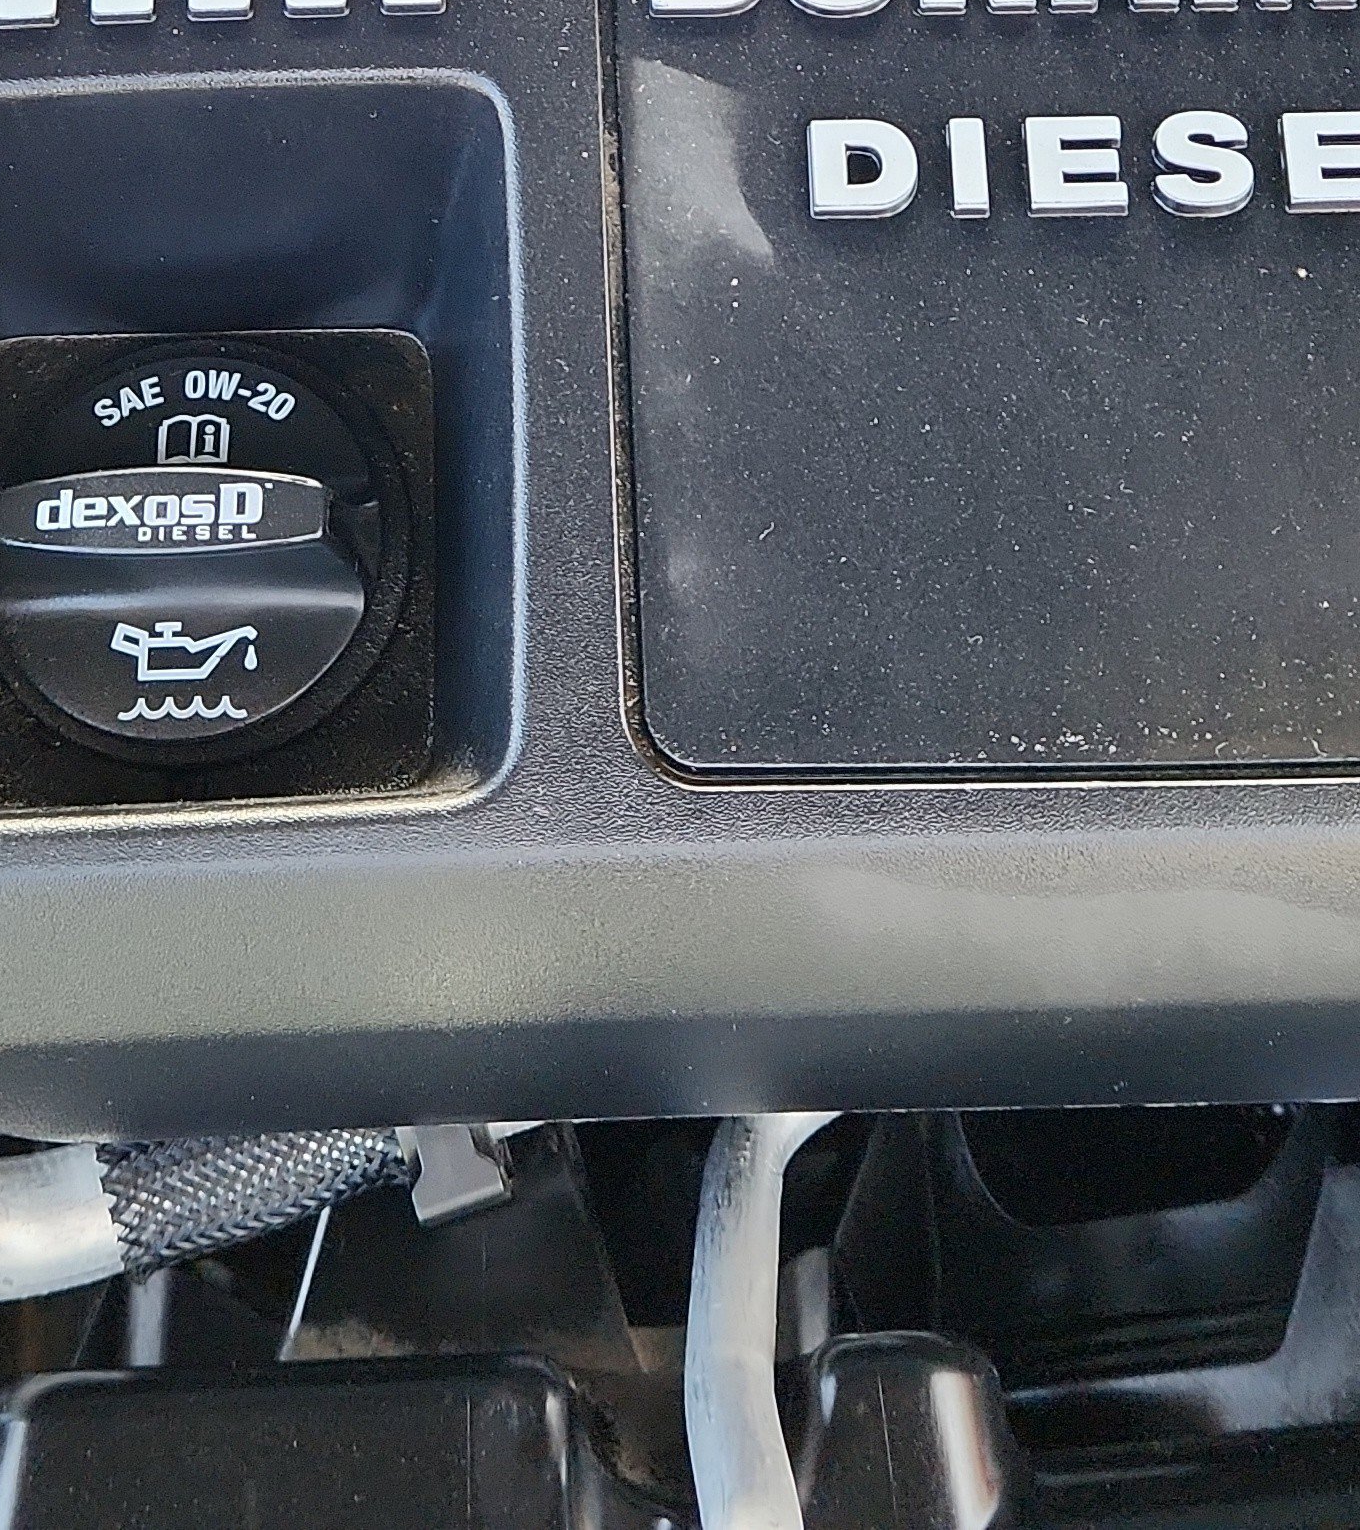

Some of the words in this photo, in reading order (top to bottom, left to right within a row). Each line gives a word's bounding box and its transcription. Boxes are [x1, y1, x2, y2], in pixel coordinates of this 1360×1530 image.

[93, 376, 165, 427] SAE
[184, 369, 296, 421] 0W-20
[137, 525, 258, 543] DIESEL
